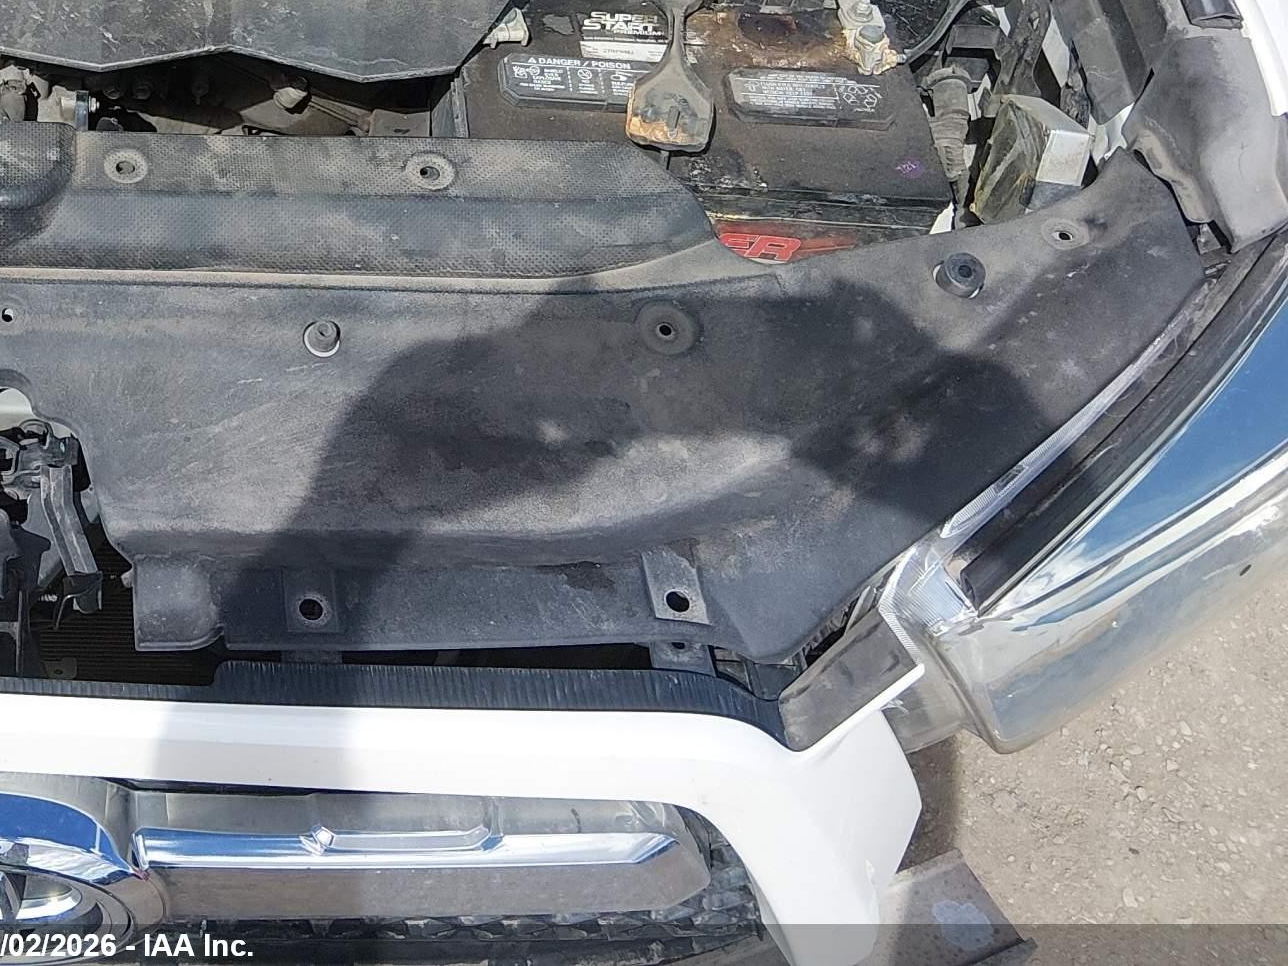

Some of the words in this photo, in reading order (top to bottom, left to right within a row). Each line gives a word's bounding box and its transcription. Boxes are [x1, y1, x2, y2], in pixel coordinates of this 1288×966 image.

[591, 11, 658, 23] SUPER
[582, 19, 659, 30] START
[538, 57, 581, 67] DANGER
[591, 60, 631, 70] POISON
